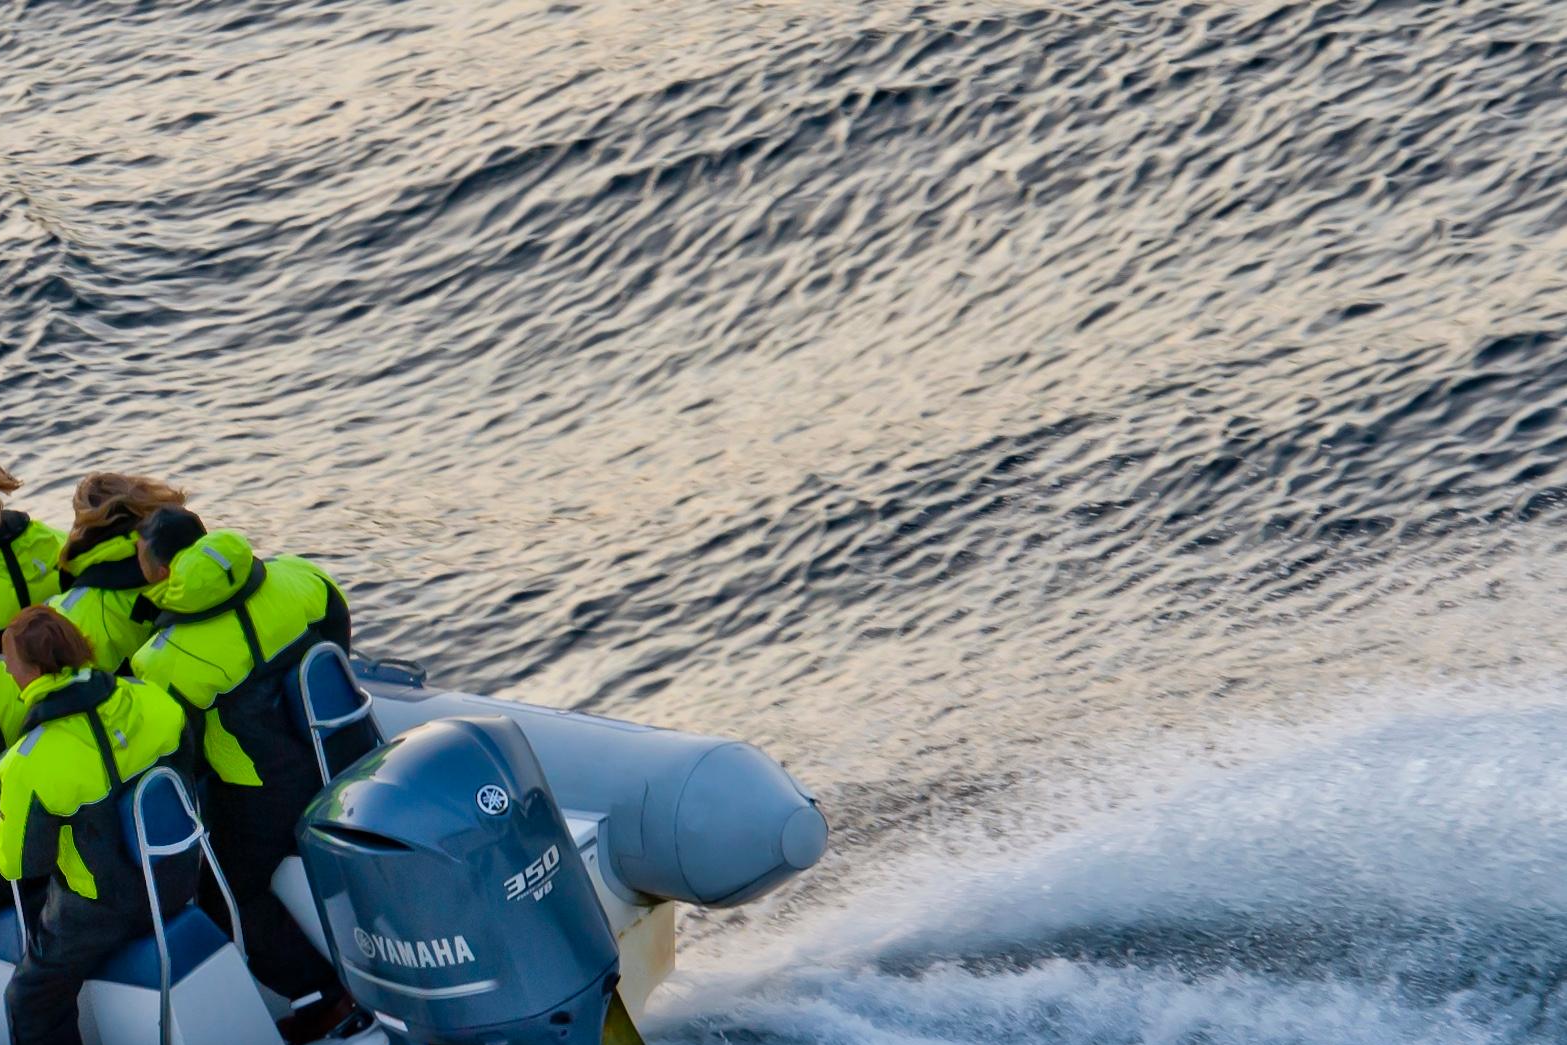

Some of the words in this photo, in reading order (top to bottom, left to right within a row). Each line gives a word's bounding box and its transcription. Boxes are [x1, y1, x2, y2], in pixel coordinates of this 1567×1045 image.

[503, 844, 560, 901] 350
[533, 880, 553, 901] V8
[372, 934, 475, 968] YAMAHA
